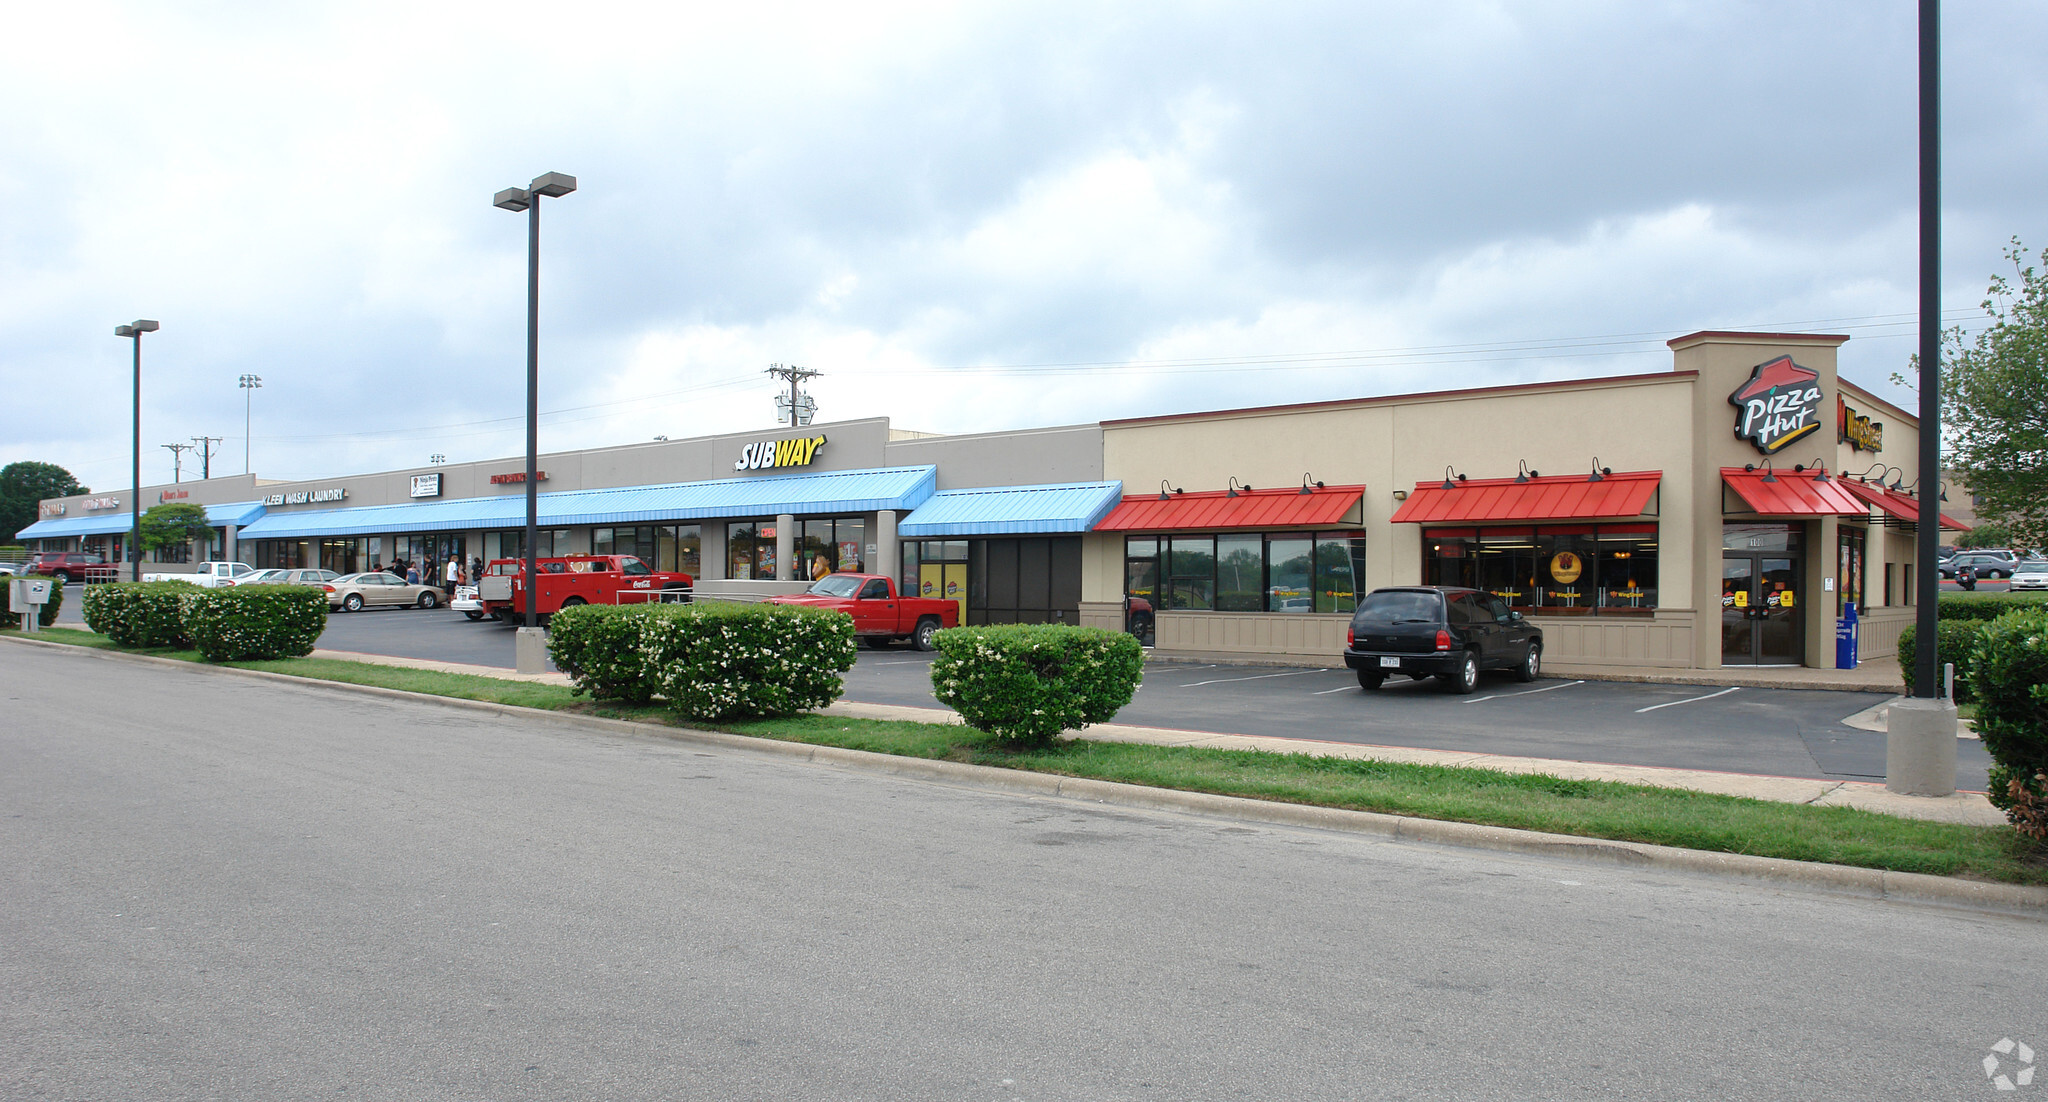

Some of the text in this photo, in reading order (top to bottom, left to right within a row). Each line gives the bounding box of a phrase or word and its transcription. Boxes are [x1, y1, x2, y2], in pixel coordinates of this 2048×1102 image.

[1744, 387, 1820, 436] Pizza
[1757, 406, 1815, 444] Hut
[1846, 407, 1883, 451] WingStreet
[735, 434, 826, 471] SUBWAY
[262, 488, 345, 506] KLEEN WASH LAUNDRY
[761, 528, 776, 538] OPEN
